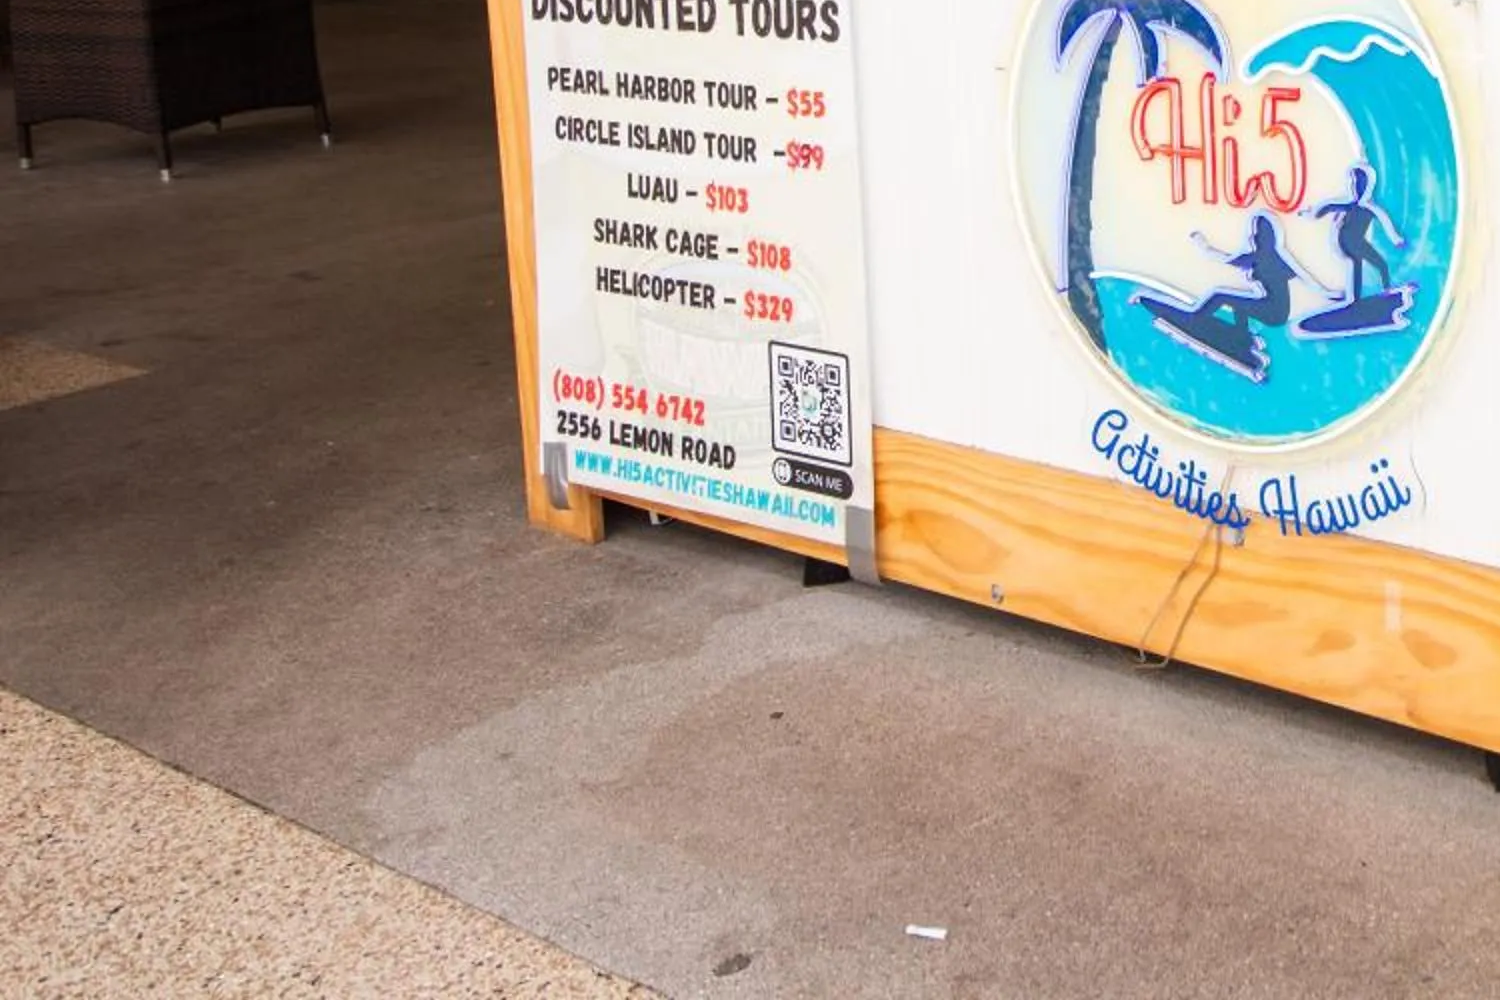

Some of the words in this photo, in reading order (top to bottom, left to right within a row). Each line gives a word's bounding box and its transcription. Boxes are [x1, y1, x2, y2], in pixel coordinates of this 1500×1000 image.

[547, 66, 609, 96] PEARL
[616, 72, 696, 105] HARBOR
[704, 81, 757, 111] TOUR
[786, 87, 827, 119] $55
[555, 115, 621, 147] CIRCLE
[627, 122, 696, 156] ISLAND
[704, 132, 757, 163] TOUR
[1130, 70, 1308, 213] Hi5
[627, 172, 679, 204] LUAU
[705, 182, 749, 214] $103
[593, 217, 659, 250] SHARK
[665, 228, 719, 261] CAGE
[747, 238, 792, 271] $108
[595, 266, 716, 310] HELICOPTER
[743, 290, 793, 323] $329
[553, 368, 605, 409] (808)
[611, 387, 648, 416] 554
[655, 395, 706, 427] 6742
[556, 410, 602, 442] 2556
[608, 420, 673, 458] LEMON
[681, 436, 737, 471] ROAD
[793, 468, 824, 488] SCAN
[825, 477, 844, 493] ME
[1091, 408, 1250, 530] Activities
[1259, 458, 1412, 537] Hawaii
